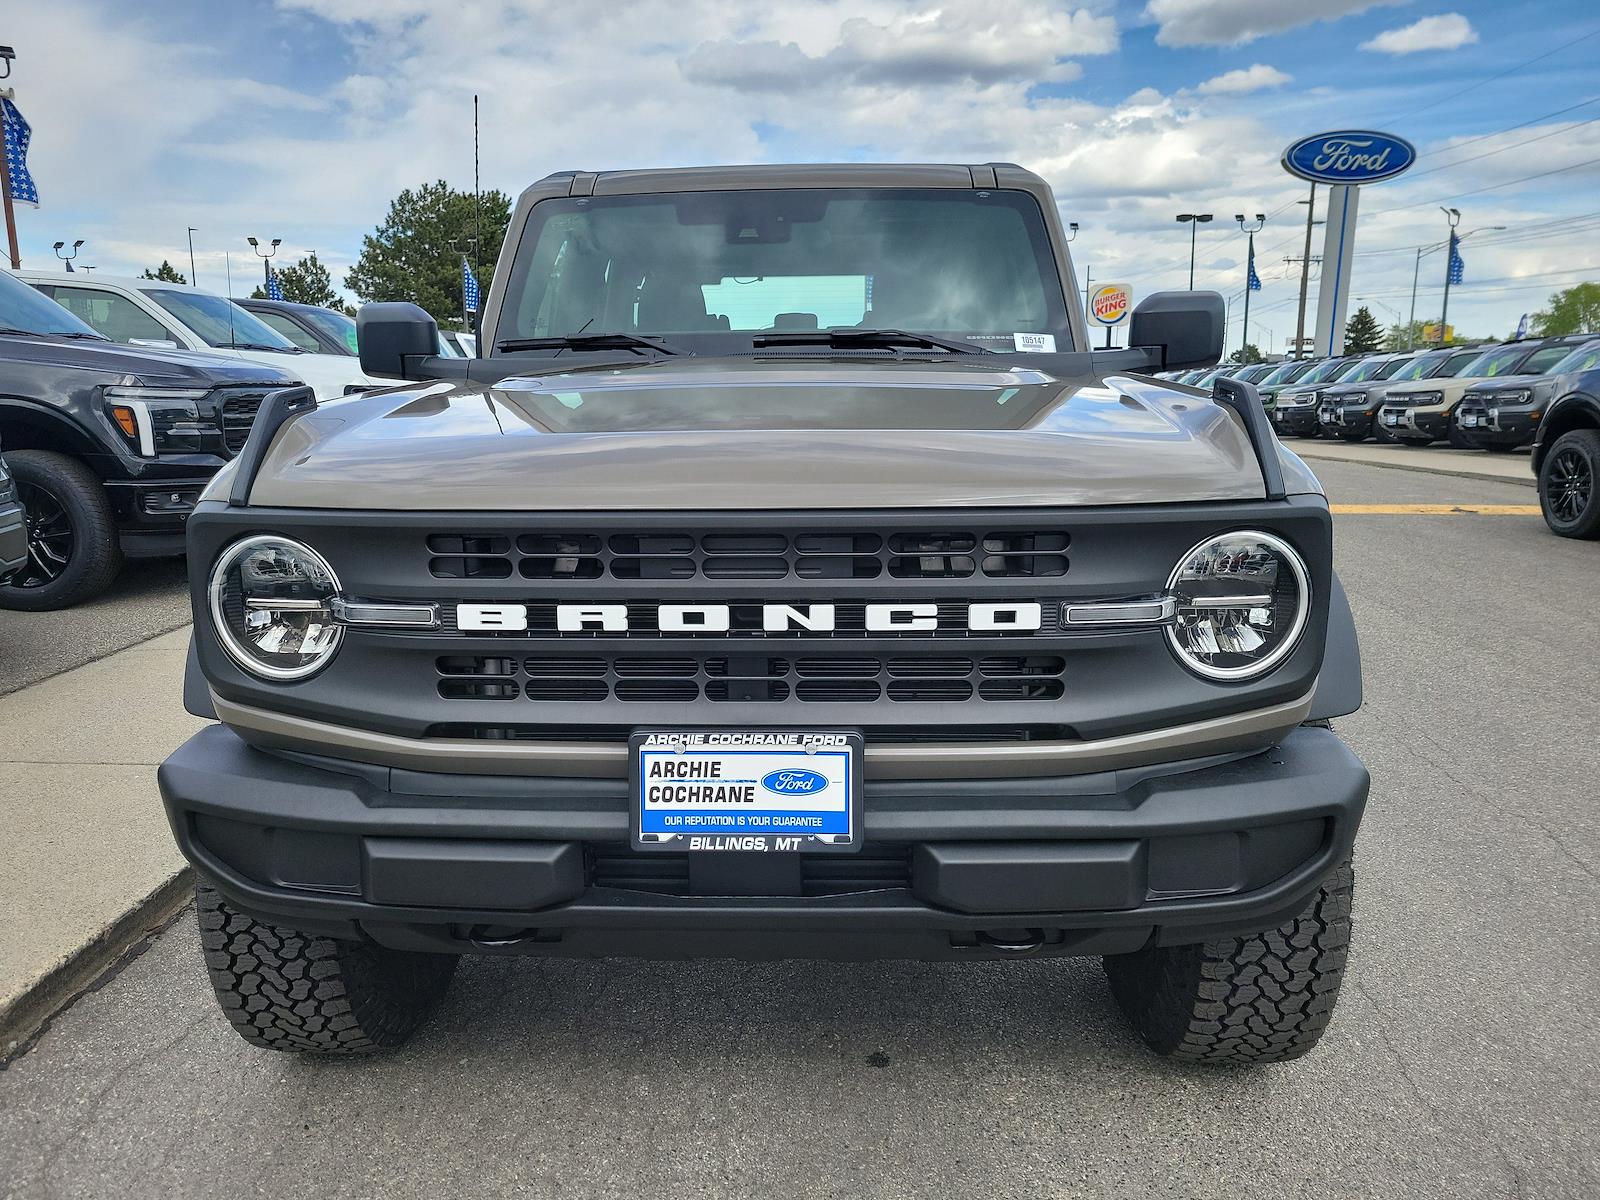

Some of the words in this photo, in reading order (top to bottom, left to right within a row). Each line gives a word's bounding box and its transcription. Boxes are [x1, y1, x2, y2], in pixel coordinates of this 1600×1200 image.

[1313, 139, 1392, 171] Ford
[1096, 300, 1126, 316] KING
[456, 603, 1041, 631] BRONCO
[645, 734, 704, 746] ARCHIE
[708, 734, 798, 745] COCHRANE
[801, 735, 847, 747] FORD
[649, 761, 722, 778] ARCHIE
[775, 772, 814, 791] Ford
[648, 785, 755, 803] COCHRANE
[664, 816, 682, 826] OUR
[684, 816, 735, 826] REPUTATION
[737, 816, 745, 826] IS
[748, 816, 770, 826] YOUR
[772, 816, 823, 827] GUARANTEE
[689, 837, 769, 852] BILLINGS,
[775, 837, 802, 850] MT
